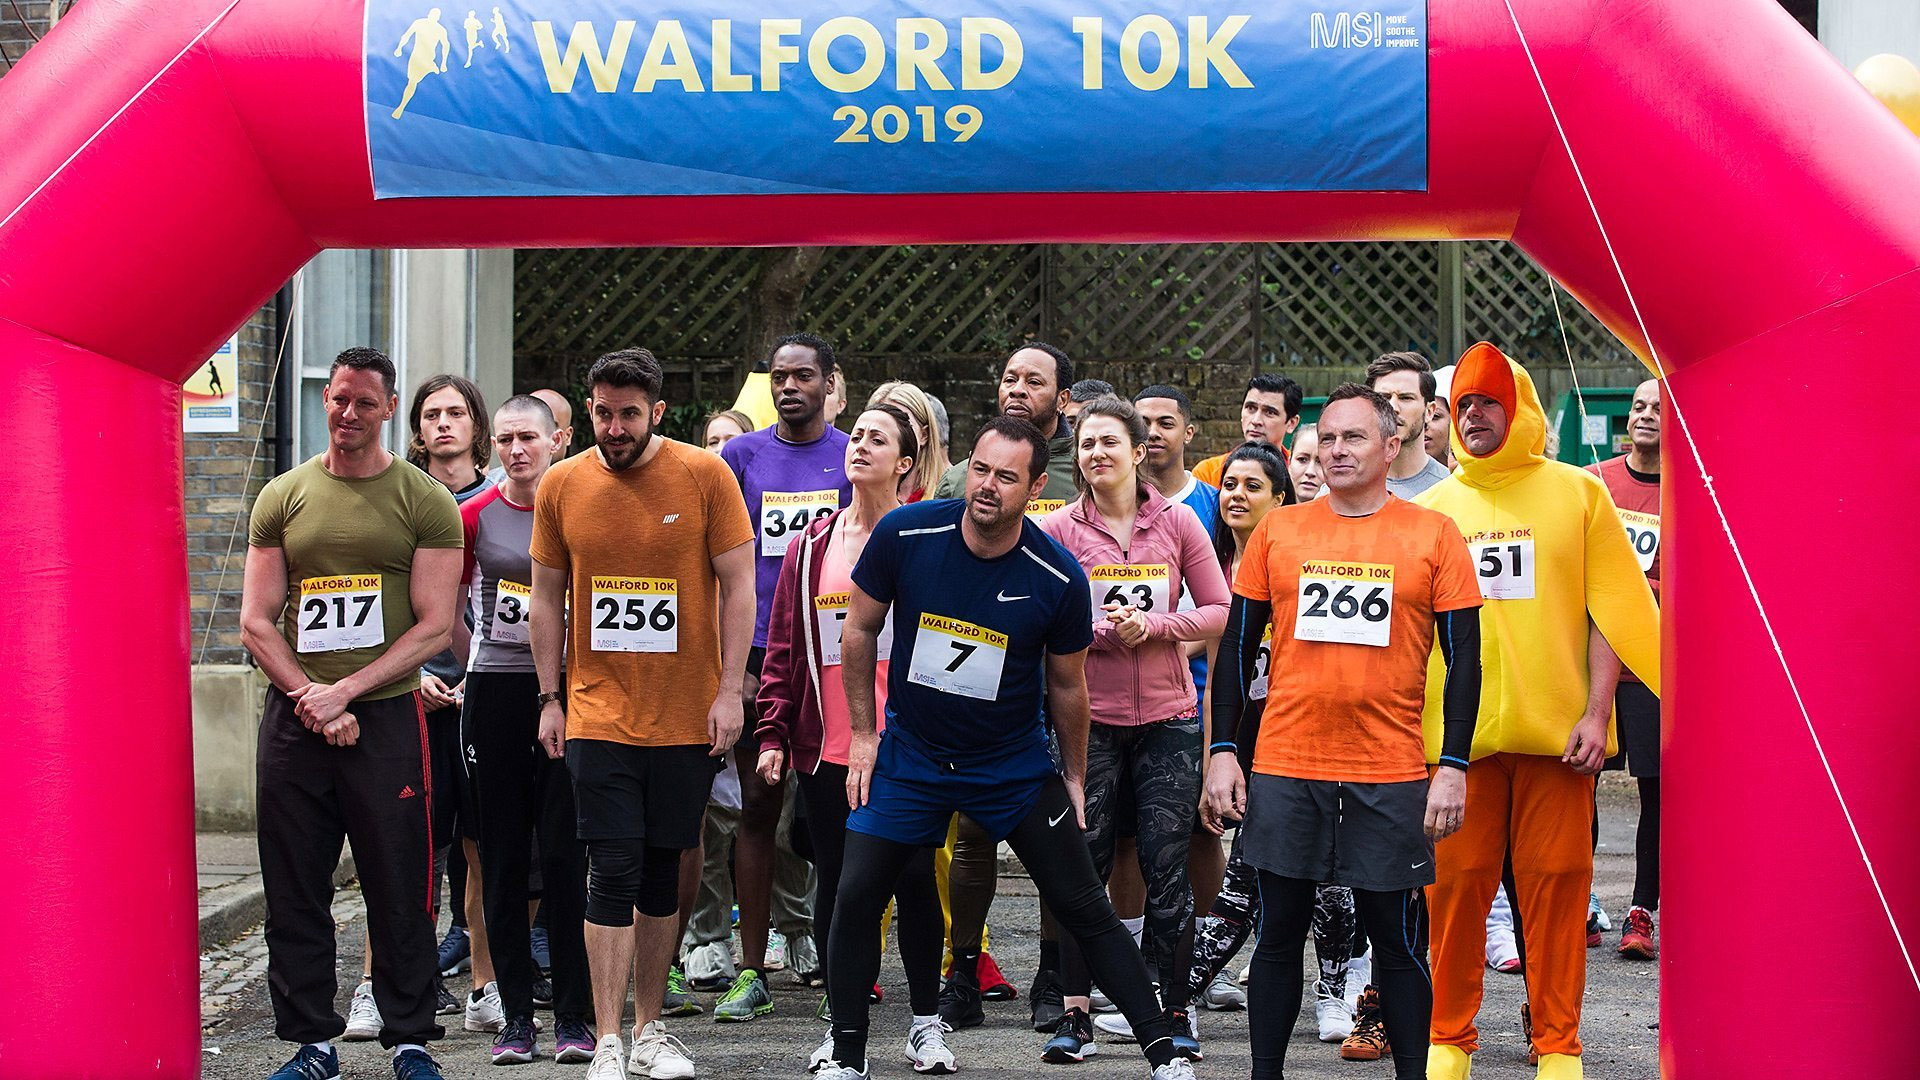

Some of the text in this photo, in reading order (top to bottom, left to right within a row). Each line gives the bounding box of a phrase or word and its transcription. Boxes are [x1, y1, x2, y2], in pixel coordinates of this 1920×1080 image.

[1386, 15, 1408, 25] MOVE
[1386, 26, 1417, 36] SOOTHE
[1386, 38, 1420, 48] IMPROVE
[532, 13, 1256, 95] WALFORD 10K
[832, 104, 984, 144] 2019
[764, 492, 836, 504] WALFORD 10K
[1618, 511, 1644, 523] FORD
[1510, 528, 1532, 539] 10K
[1479, 544, 1522, 578] 51
[1091, 567, 1167, 578] WALFORD 10K
[1302, 564, 1391, 579] WALFORD 10K
[302, 577, 379, 592] WALFORD 10K
[594, 579, 675, 591] WALFORD 10K
[816, 595, 850, 606] WALF
[1103, 584, 1154, 613] 63
[1301, 582, 1390, 623] 266
[303, 594, 379, 632] 217
[497, 595, 530, 625] 3
[595, 596, 676, 632] 256
[922, 616, 1006, 646] WALFORD 10K
[944, 640, 979, 673] 7
